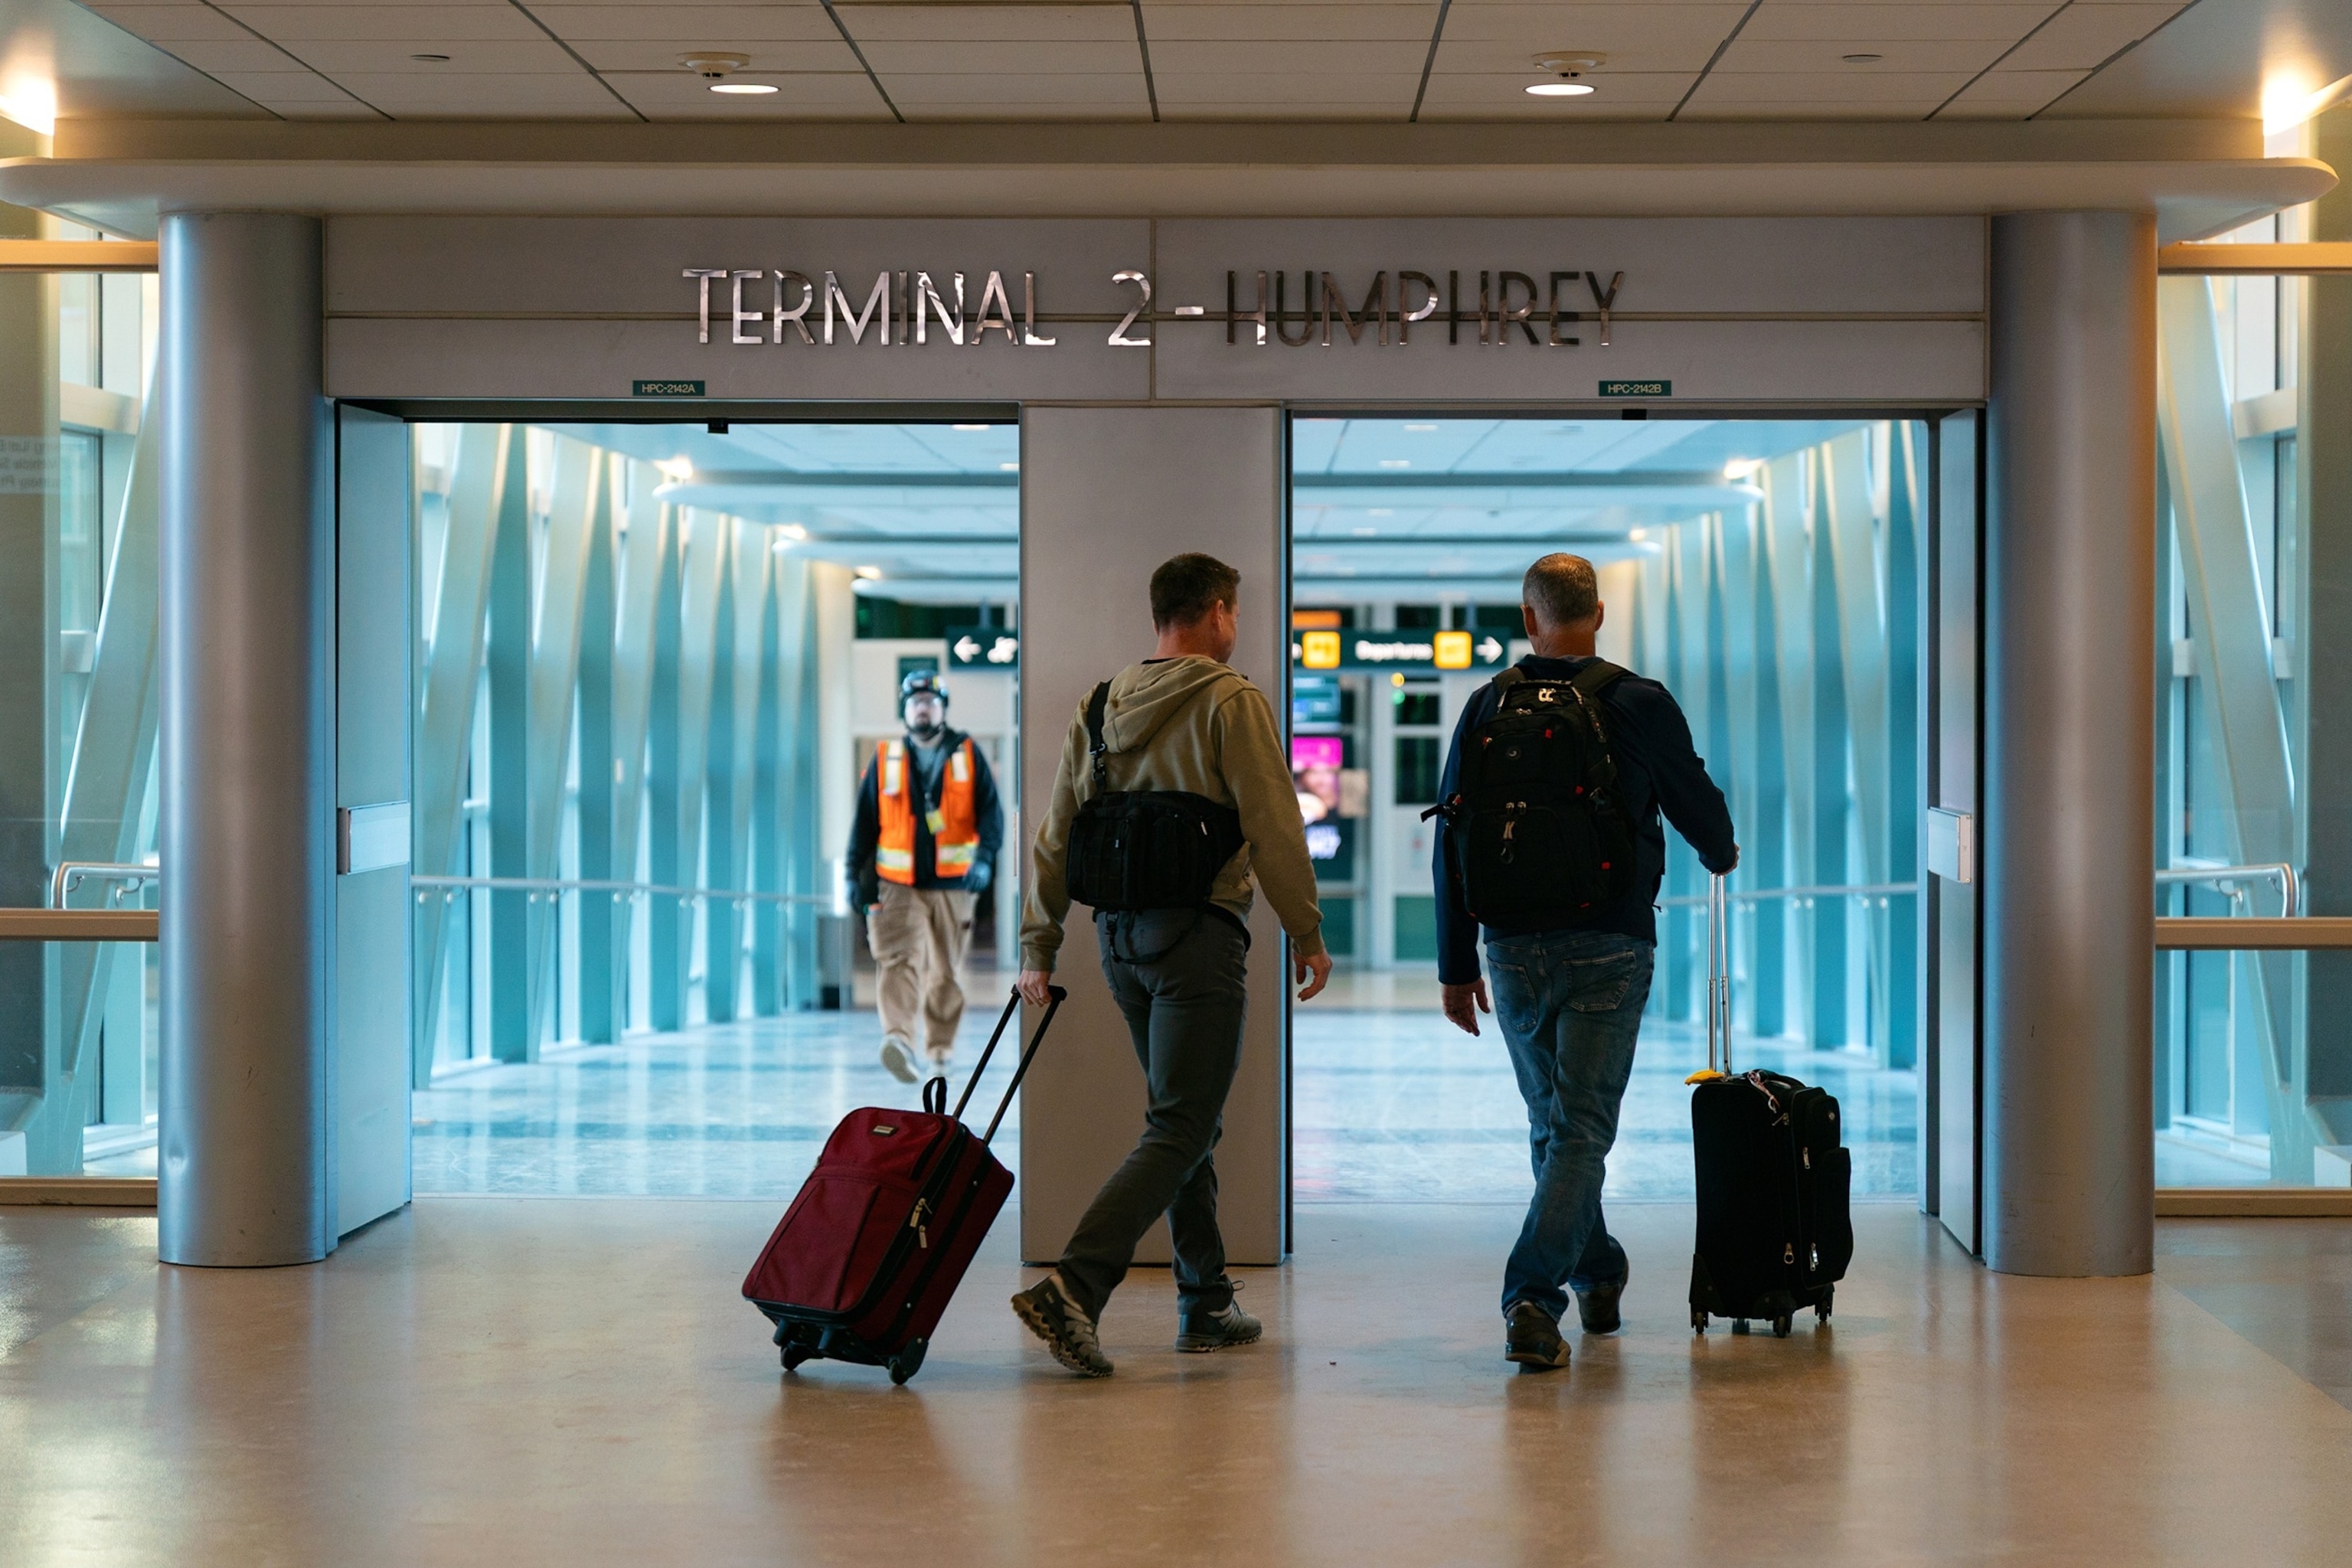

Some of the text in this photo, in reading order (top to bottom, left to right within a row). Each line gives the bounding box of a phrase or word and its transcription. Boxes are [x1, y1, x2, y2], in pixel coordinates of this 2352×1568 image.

[683, 269, 1057, 346] TERMINAL
[1108, 270, 1152, 346] 2
[1227, 270, 1625, 347] HUMPHREY
[641, 384, 696, 394] HPC-2142A
[1607, 384, 1662, 394] HPC-2142B
